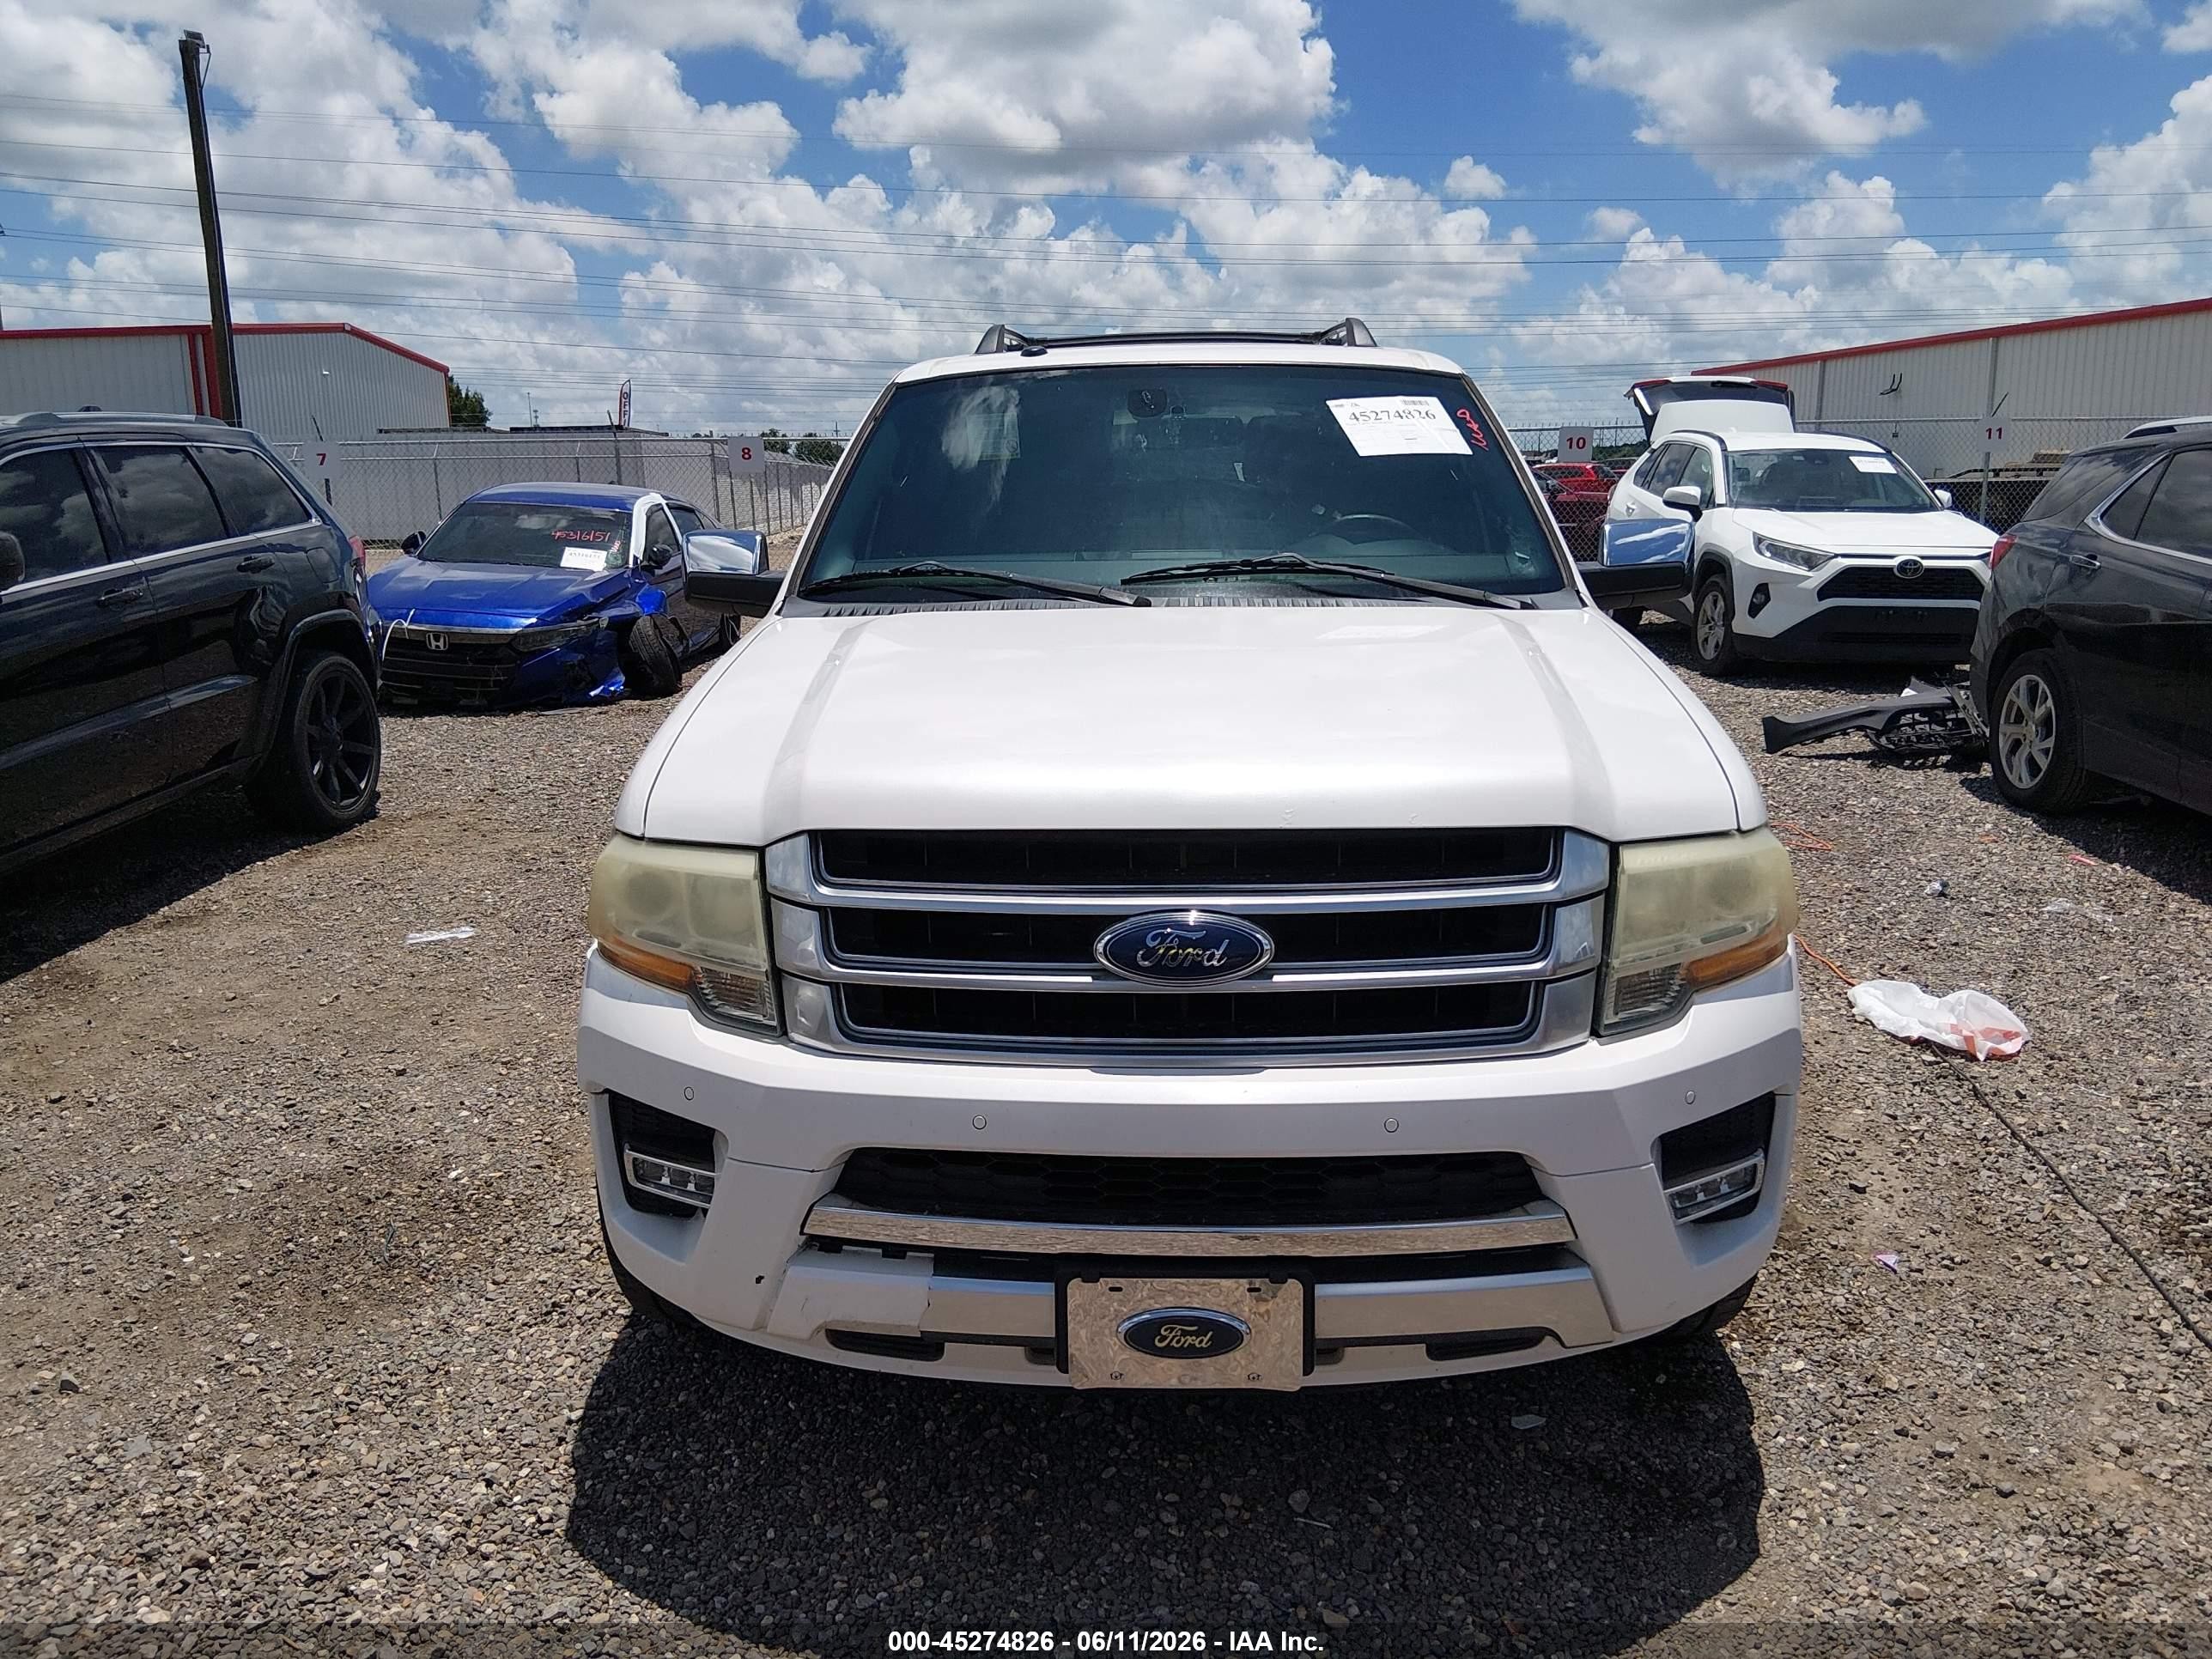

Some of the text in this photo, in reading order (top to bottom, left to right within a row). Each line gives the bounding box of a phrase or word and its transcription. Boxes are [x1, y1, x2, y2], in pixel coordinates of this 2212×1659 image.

[1348, 409, 1437, 422] 45274826
[1985, 427, 2002, 440] 11
[1566, 436, 1586, 449] 10
[316, 453, 326, 465] 7
[741, 447, 752, 460] 8
[1136, 928, 1230, 967] Ford
[1154, 1324, 1212, 1348] Ford
